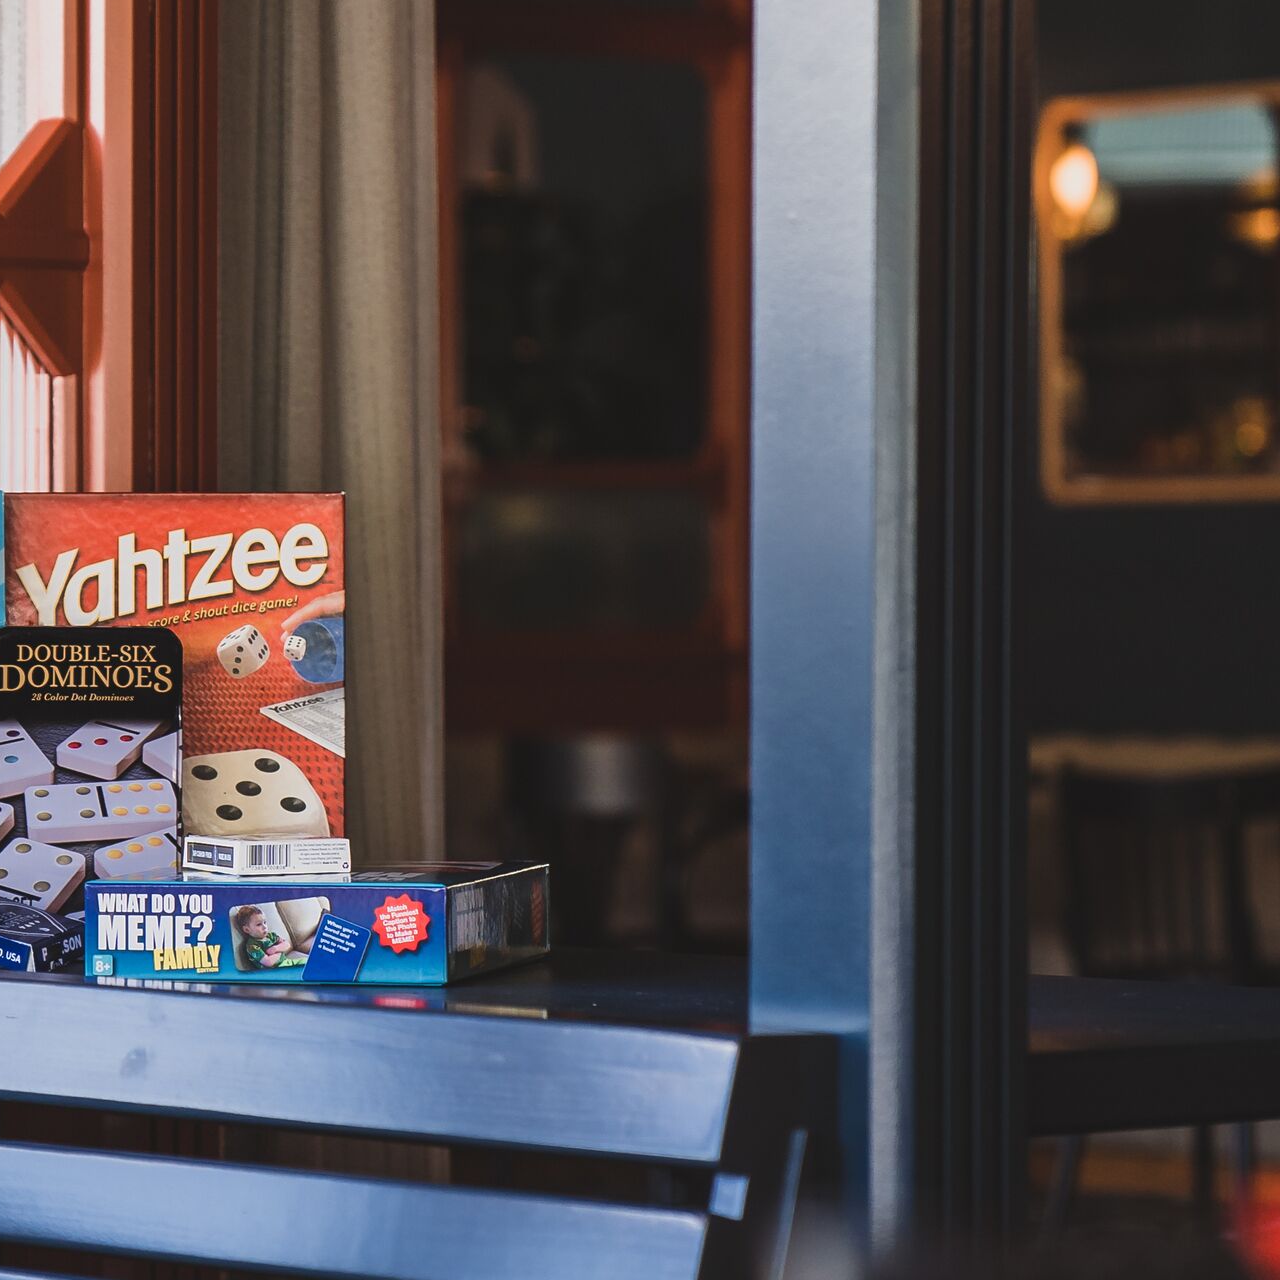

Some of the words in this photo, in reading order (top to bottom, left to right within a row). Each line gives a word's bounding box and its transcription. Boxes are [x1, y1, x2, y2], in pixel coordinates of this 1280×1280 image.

[16, 523, 328, 628] Yahtzee
[148, 613, 179, 627] score
[182, 609, 191, 622] &
[194, 604, 228, 620] shout
[231, 600, 257, 614] dice
[259, 595, 298, 613] game!
[16, 644, 157, 663] DOUBLE-SIX
[0, 664, 173, 693] DOMINOES
[31, 693, 42, 701] 28
[44, 693, 69, 701] Color
[71, 693, 87, 701] Dot
[89, 693, 135, 701] Dominoes
[268, 697, 325, 713] Yahtzee
[97, 893, 148, 913] WHAT
[151, 893, 175, 913] DO
[178, 894, 213, 914] YOU
[98, 915, 213, 951] MEME?
[6, 950, 21, 964] USA
[95, 960, 111, 972] 8+
[153, 945, 220, 971] FAMILY
